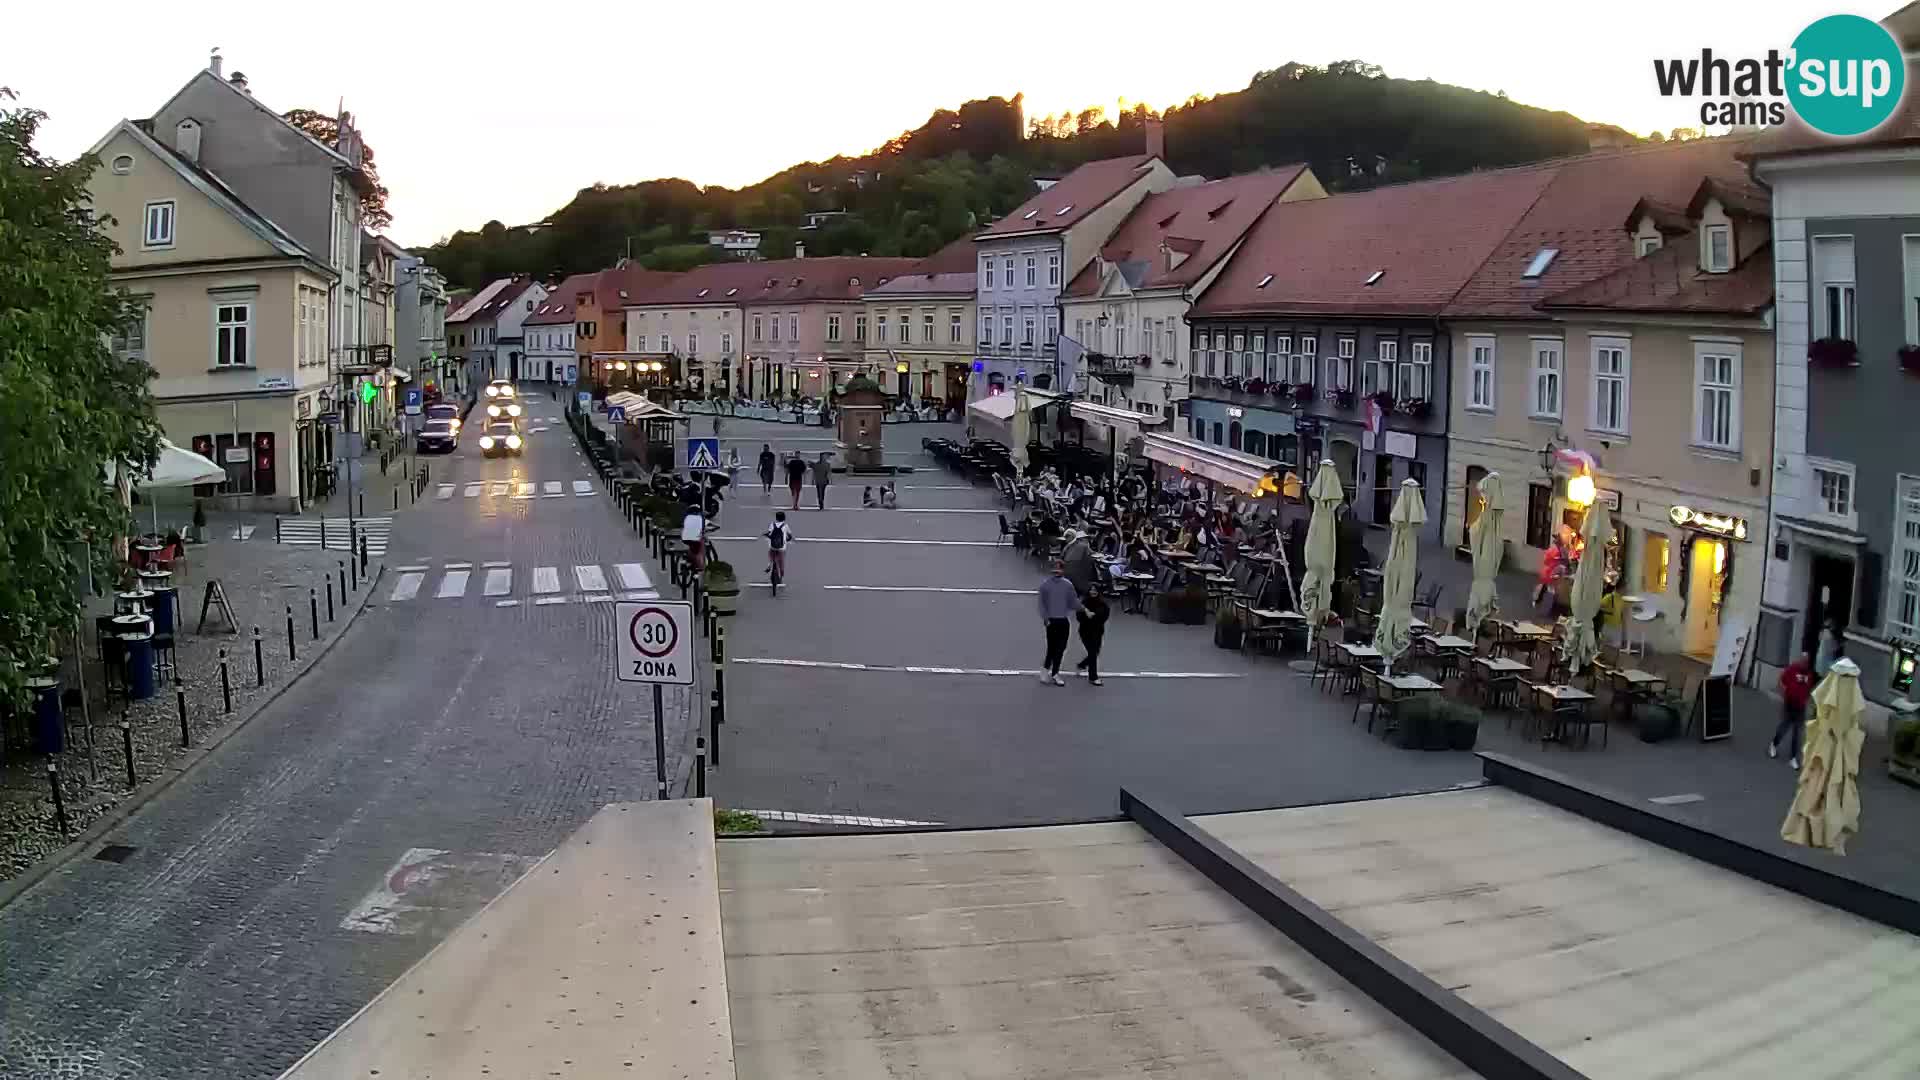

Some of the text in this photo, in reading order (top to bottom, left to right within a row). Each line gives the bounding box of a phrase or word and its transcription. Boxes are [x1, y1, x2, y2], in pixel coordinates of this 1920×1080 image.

[409, 391, 417, 403] P
[642, 623, 667, 645] 30
[633, 660, 677, 677] ZONA
